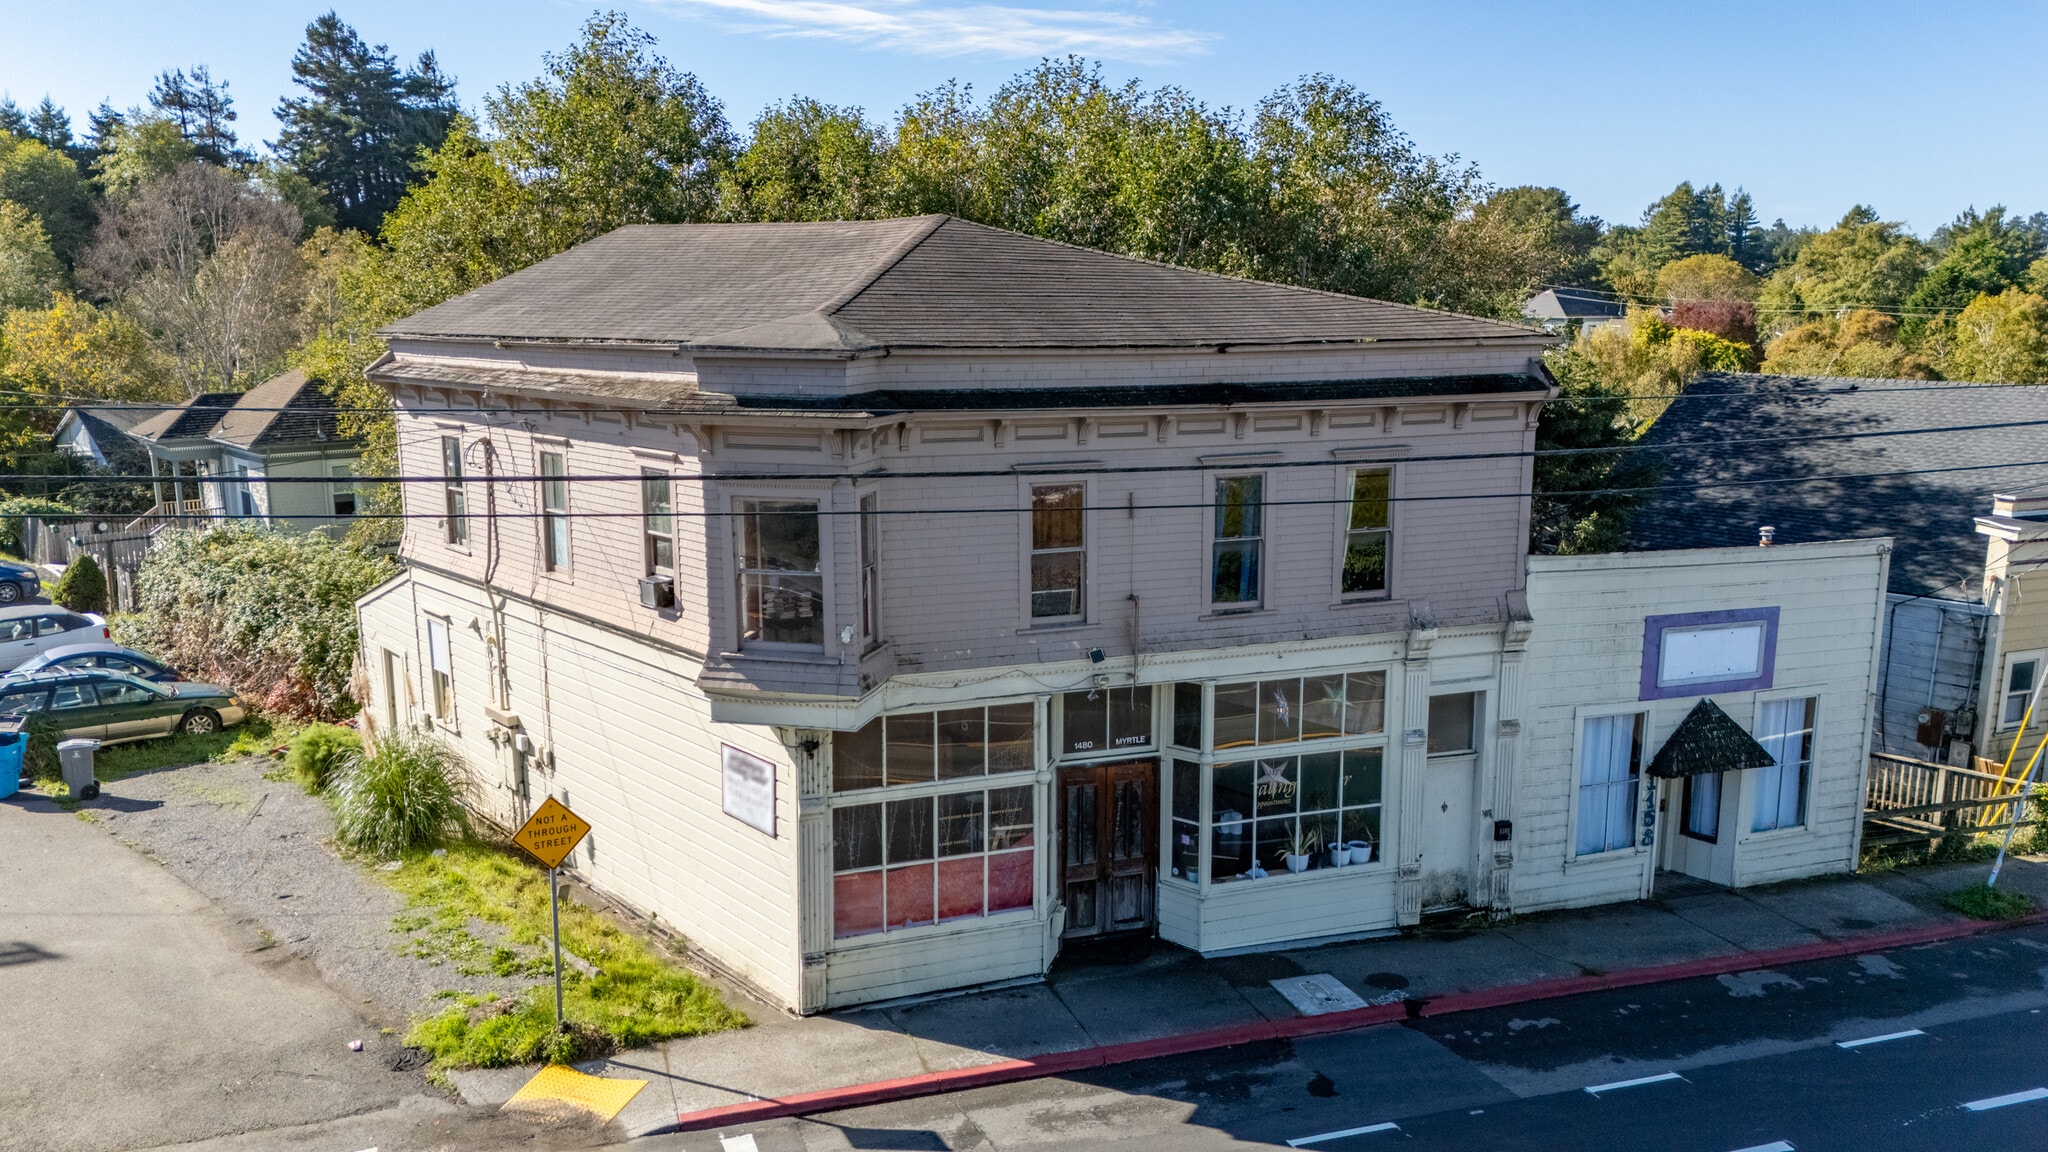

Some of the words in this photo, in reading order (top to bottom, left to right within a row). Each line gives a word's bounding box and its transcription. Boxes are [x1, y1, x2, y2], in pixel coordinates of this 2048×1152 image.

[1074, 741, 1093, 750] 1480
[1115, 735, 1146, 746] MYRTLE
[536, 815, 555, 826] NOT
[560, 813, 568, 822] A
[528, 824, 577, 839] THROUGH
[534, 836, 573, 850] STREET
